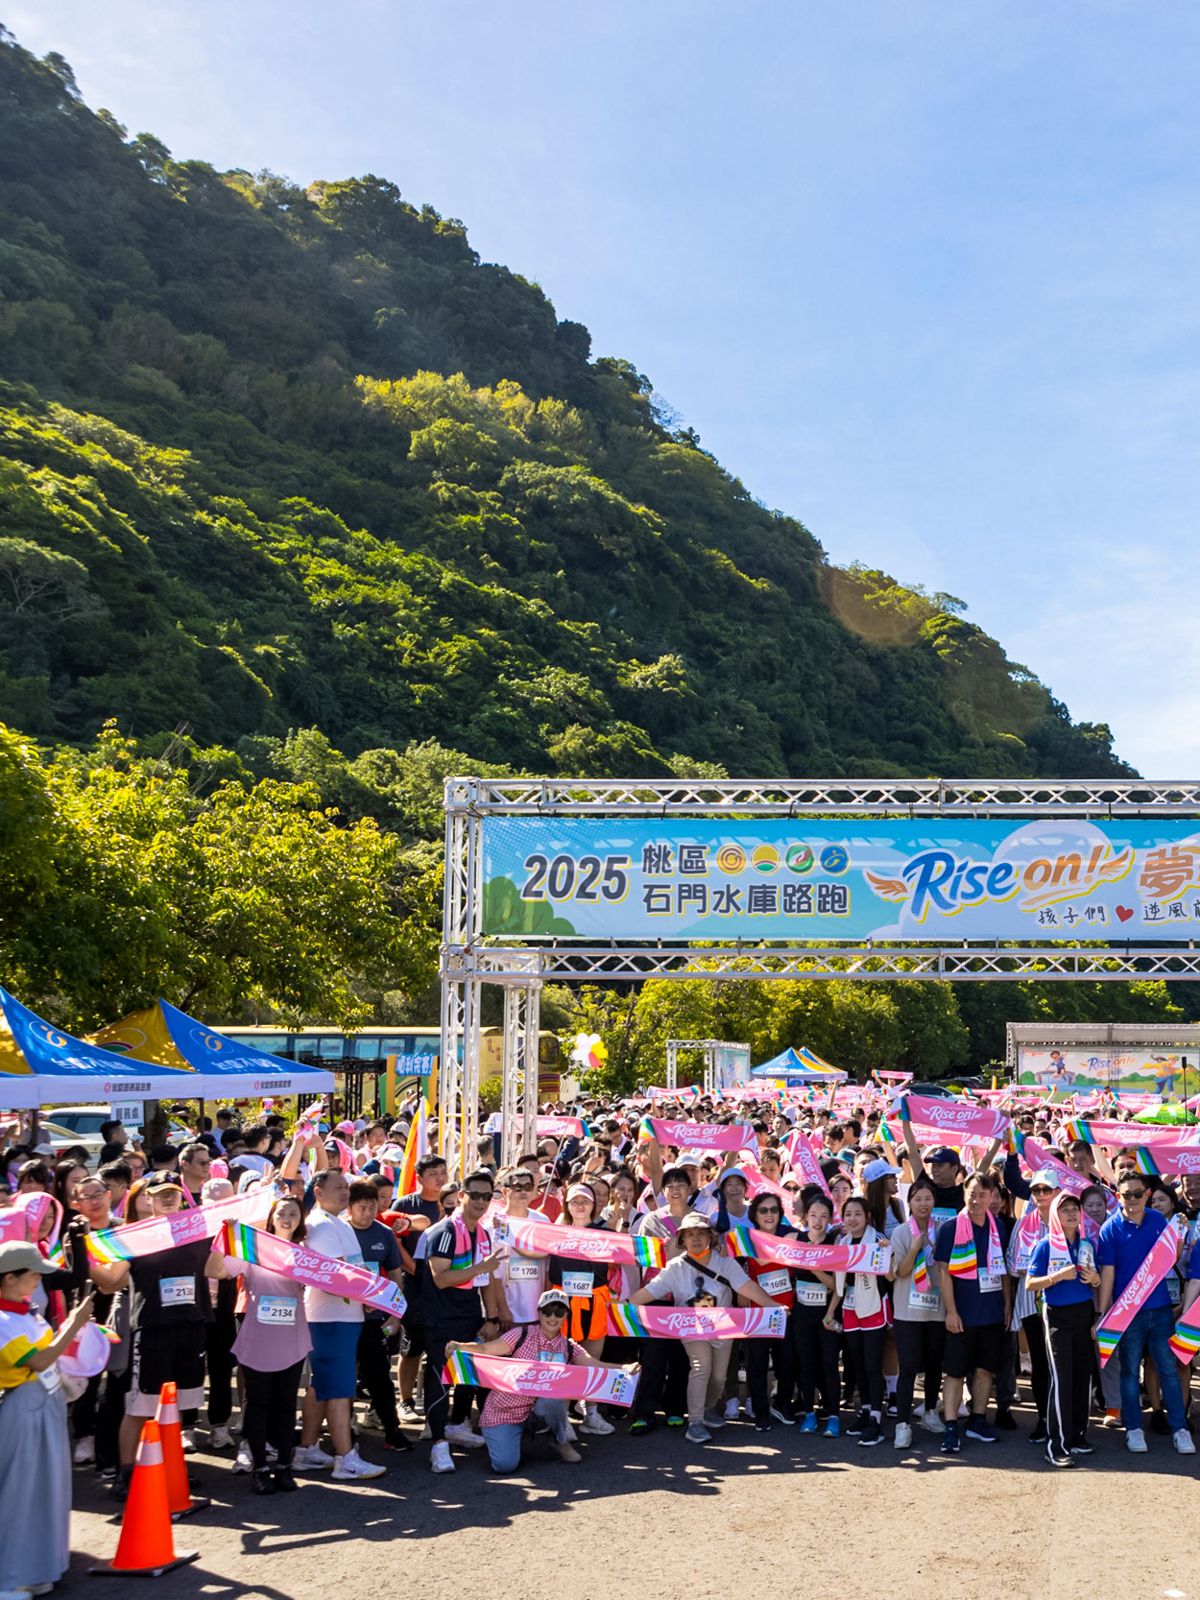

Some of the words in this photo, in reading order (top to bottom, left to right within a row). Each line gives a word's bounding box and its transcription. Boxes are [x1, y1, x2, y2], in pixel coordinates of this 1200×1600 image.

[642, 844, 708, 874] 桃區
[521, 854, 629, 901] 2025
[902, 851, 1016, 916] Rise
[1023, 845, 1105, 892] on!
[642, 883, 849, 915] 石門水庫路跑
[1038, 904, 1107, 925] 孩子們
[930, 1106, 955, 1121] Rise
[957, 1109, 976, 1120] on!
[674, 1124, 700, 1138] Rise
[702, 1126, 723, 1135] on!
[796, 1147, 815, 1172] Rise
[580, 1240, 612, 1257] Rise
[775, 1243, 804, 1259] Rise
[805, 1247, 826, 1259] on!
[284, 1247, 320, 1269] Rise
[522, 1267, 539, 1276] 1708
[572, 1281, 590, 1291] 1687
[769, 1278, 788, 1290] 1692
[806, 1292, 824, 1301] 1711
[1119, 1281, 1139, 1311] Rise
[271, 1308, 294, 1318] 2134
[668, 1313, 697, 1330] Rise
[501, 1366, 536, 1382] Rise
[537, 1366, 562, 1381] on!
